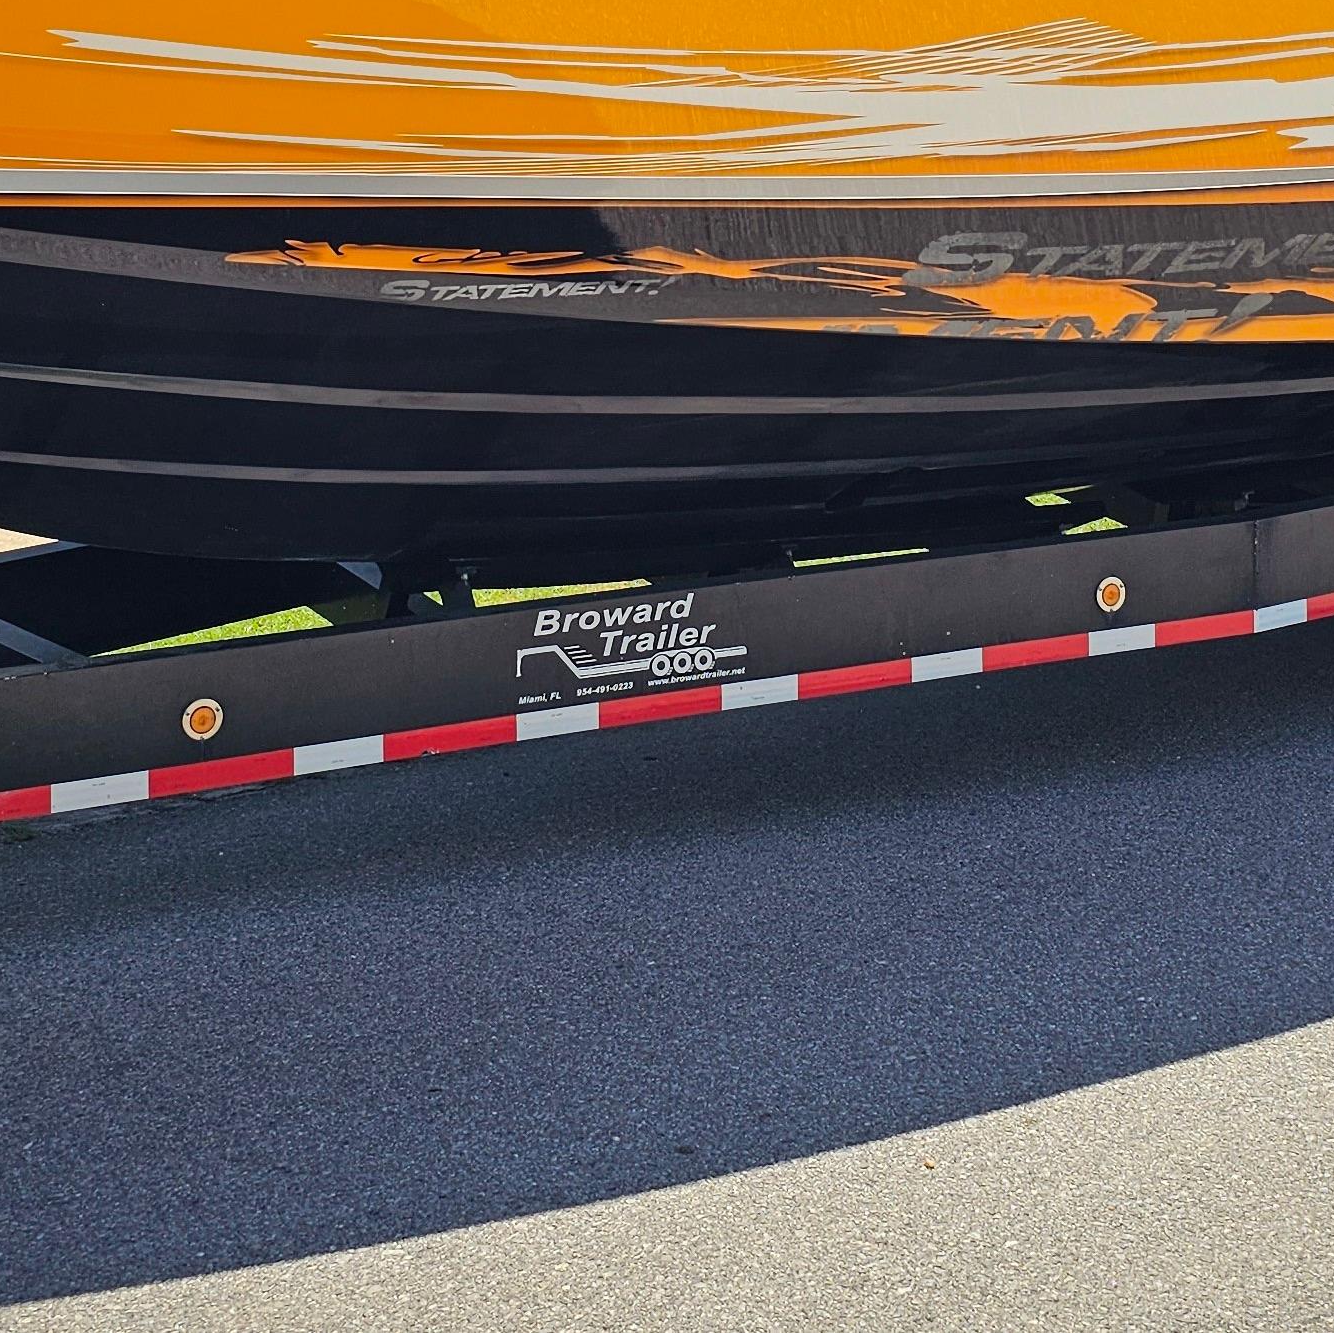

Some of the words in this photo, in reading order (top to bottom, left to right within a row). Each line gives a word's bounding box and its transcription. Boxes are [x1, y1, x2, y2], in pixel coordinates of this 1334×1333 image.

[380, 277, 679, 303] STATEMENT!
[533, 592, 695, 637] Broward
[599, 623, 716, 657] Trailer
[518, 692, 548, 705] Miami,
[550, 691, 562, 701] FL
[576, 680, 634, 697] 954-491-0223
[647, 666, 746, 687] www.browardtrailer.net
